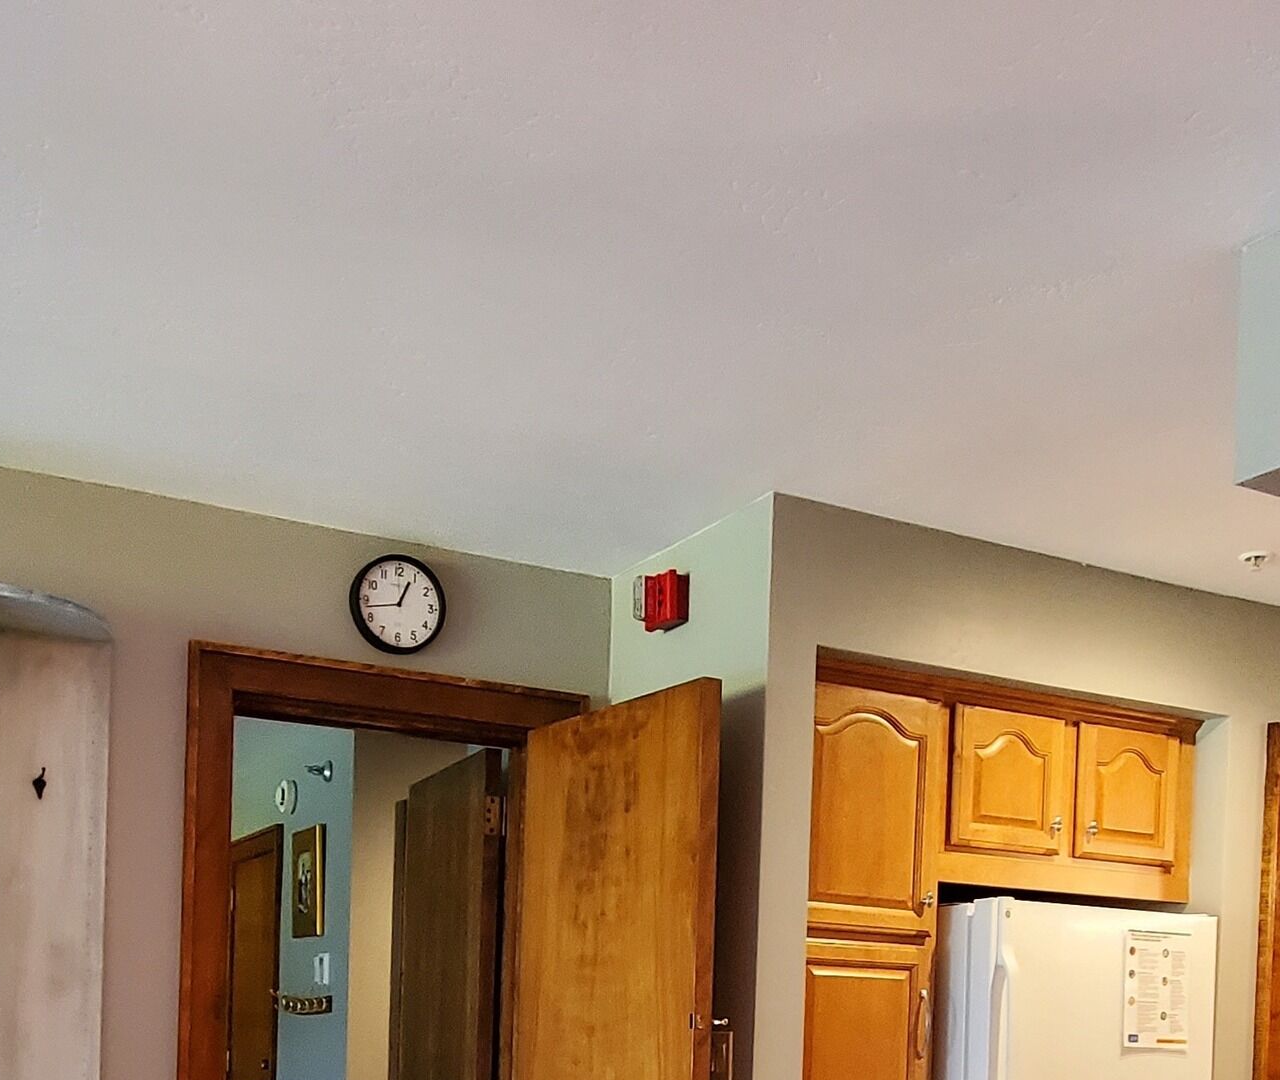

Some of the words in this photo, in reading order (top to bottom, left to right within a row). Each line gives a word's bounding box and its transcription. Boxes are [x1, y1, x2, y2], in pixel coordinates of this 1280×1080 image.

[380, 569, 387, 580] 11
[394, 566, 404, 577] 12
[368, 580, 378, 590] 10
[423, 587, 430, 597] 2
[427, 604, 434, 614] 3
[367, 612, 374, 622] 8
[379, 625, 386, 635] 7
[422, 620, 428, 631] 4
[394, 632, 401, 642] 6
[410, 631, 417, 641] 5
